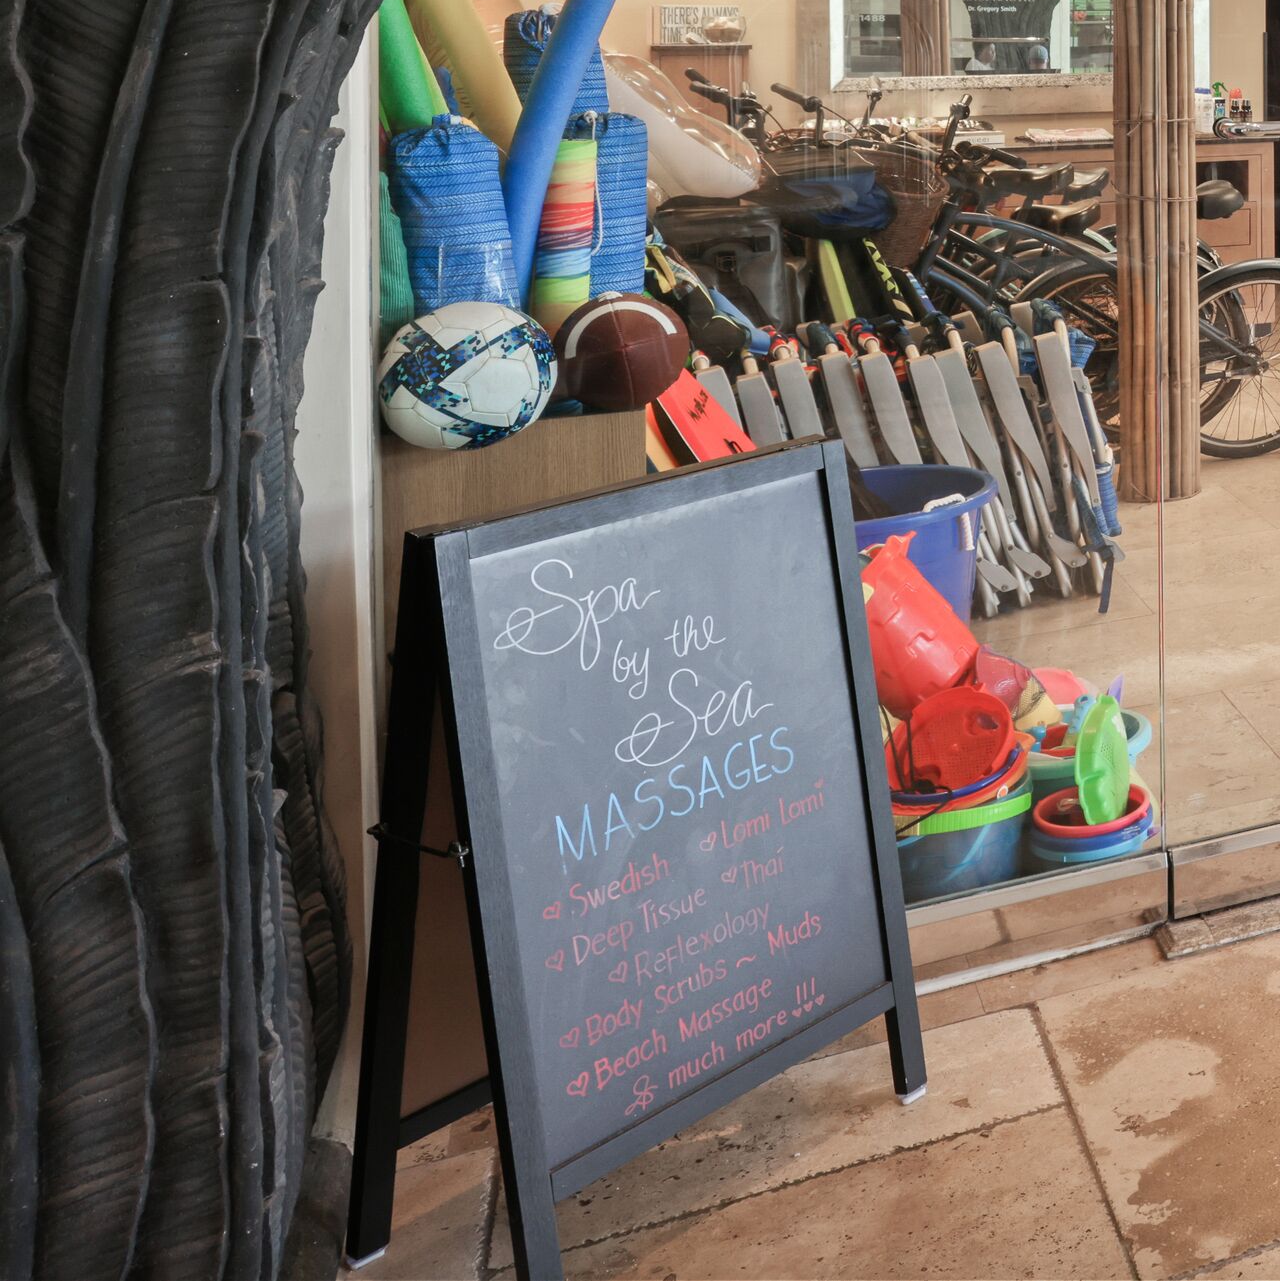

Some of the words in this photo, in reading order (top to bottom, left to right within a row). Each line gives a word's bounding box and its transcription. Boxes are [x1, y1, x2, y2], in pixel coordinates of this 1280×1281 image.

[662, 7, 699, 25] THERE'S
[493, 559, 661, 671] Spa
[612, 640, 650, 700] by
[664, 615, 727, 657] the
[615, 668, 774, 767] Sea
[555, 726, 795, 863] MASSAGES
[569, 853, 670, 917] Swedish
[720, 814, 772, 849] Lomi
[778, 777, 825, 826] Lomi
[572, 920, 634, 967] Deep
[638, 888, 708, 934] Tissue
[741, 846, 785, 889] Thai
[585, 998, 644, 1047] Body
[655, 958, 728, 1014] Scrubs
[767, 910, 823, 956] Muds
[594, 1028, 668, 1091] Beach
[678, 977, 773, 1043] Massage
[668, 1040, 726, 1089] much
